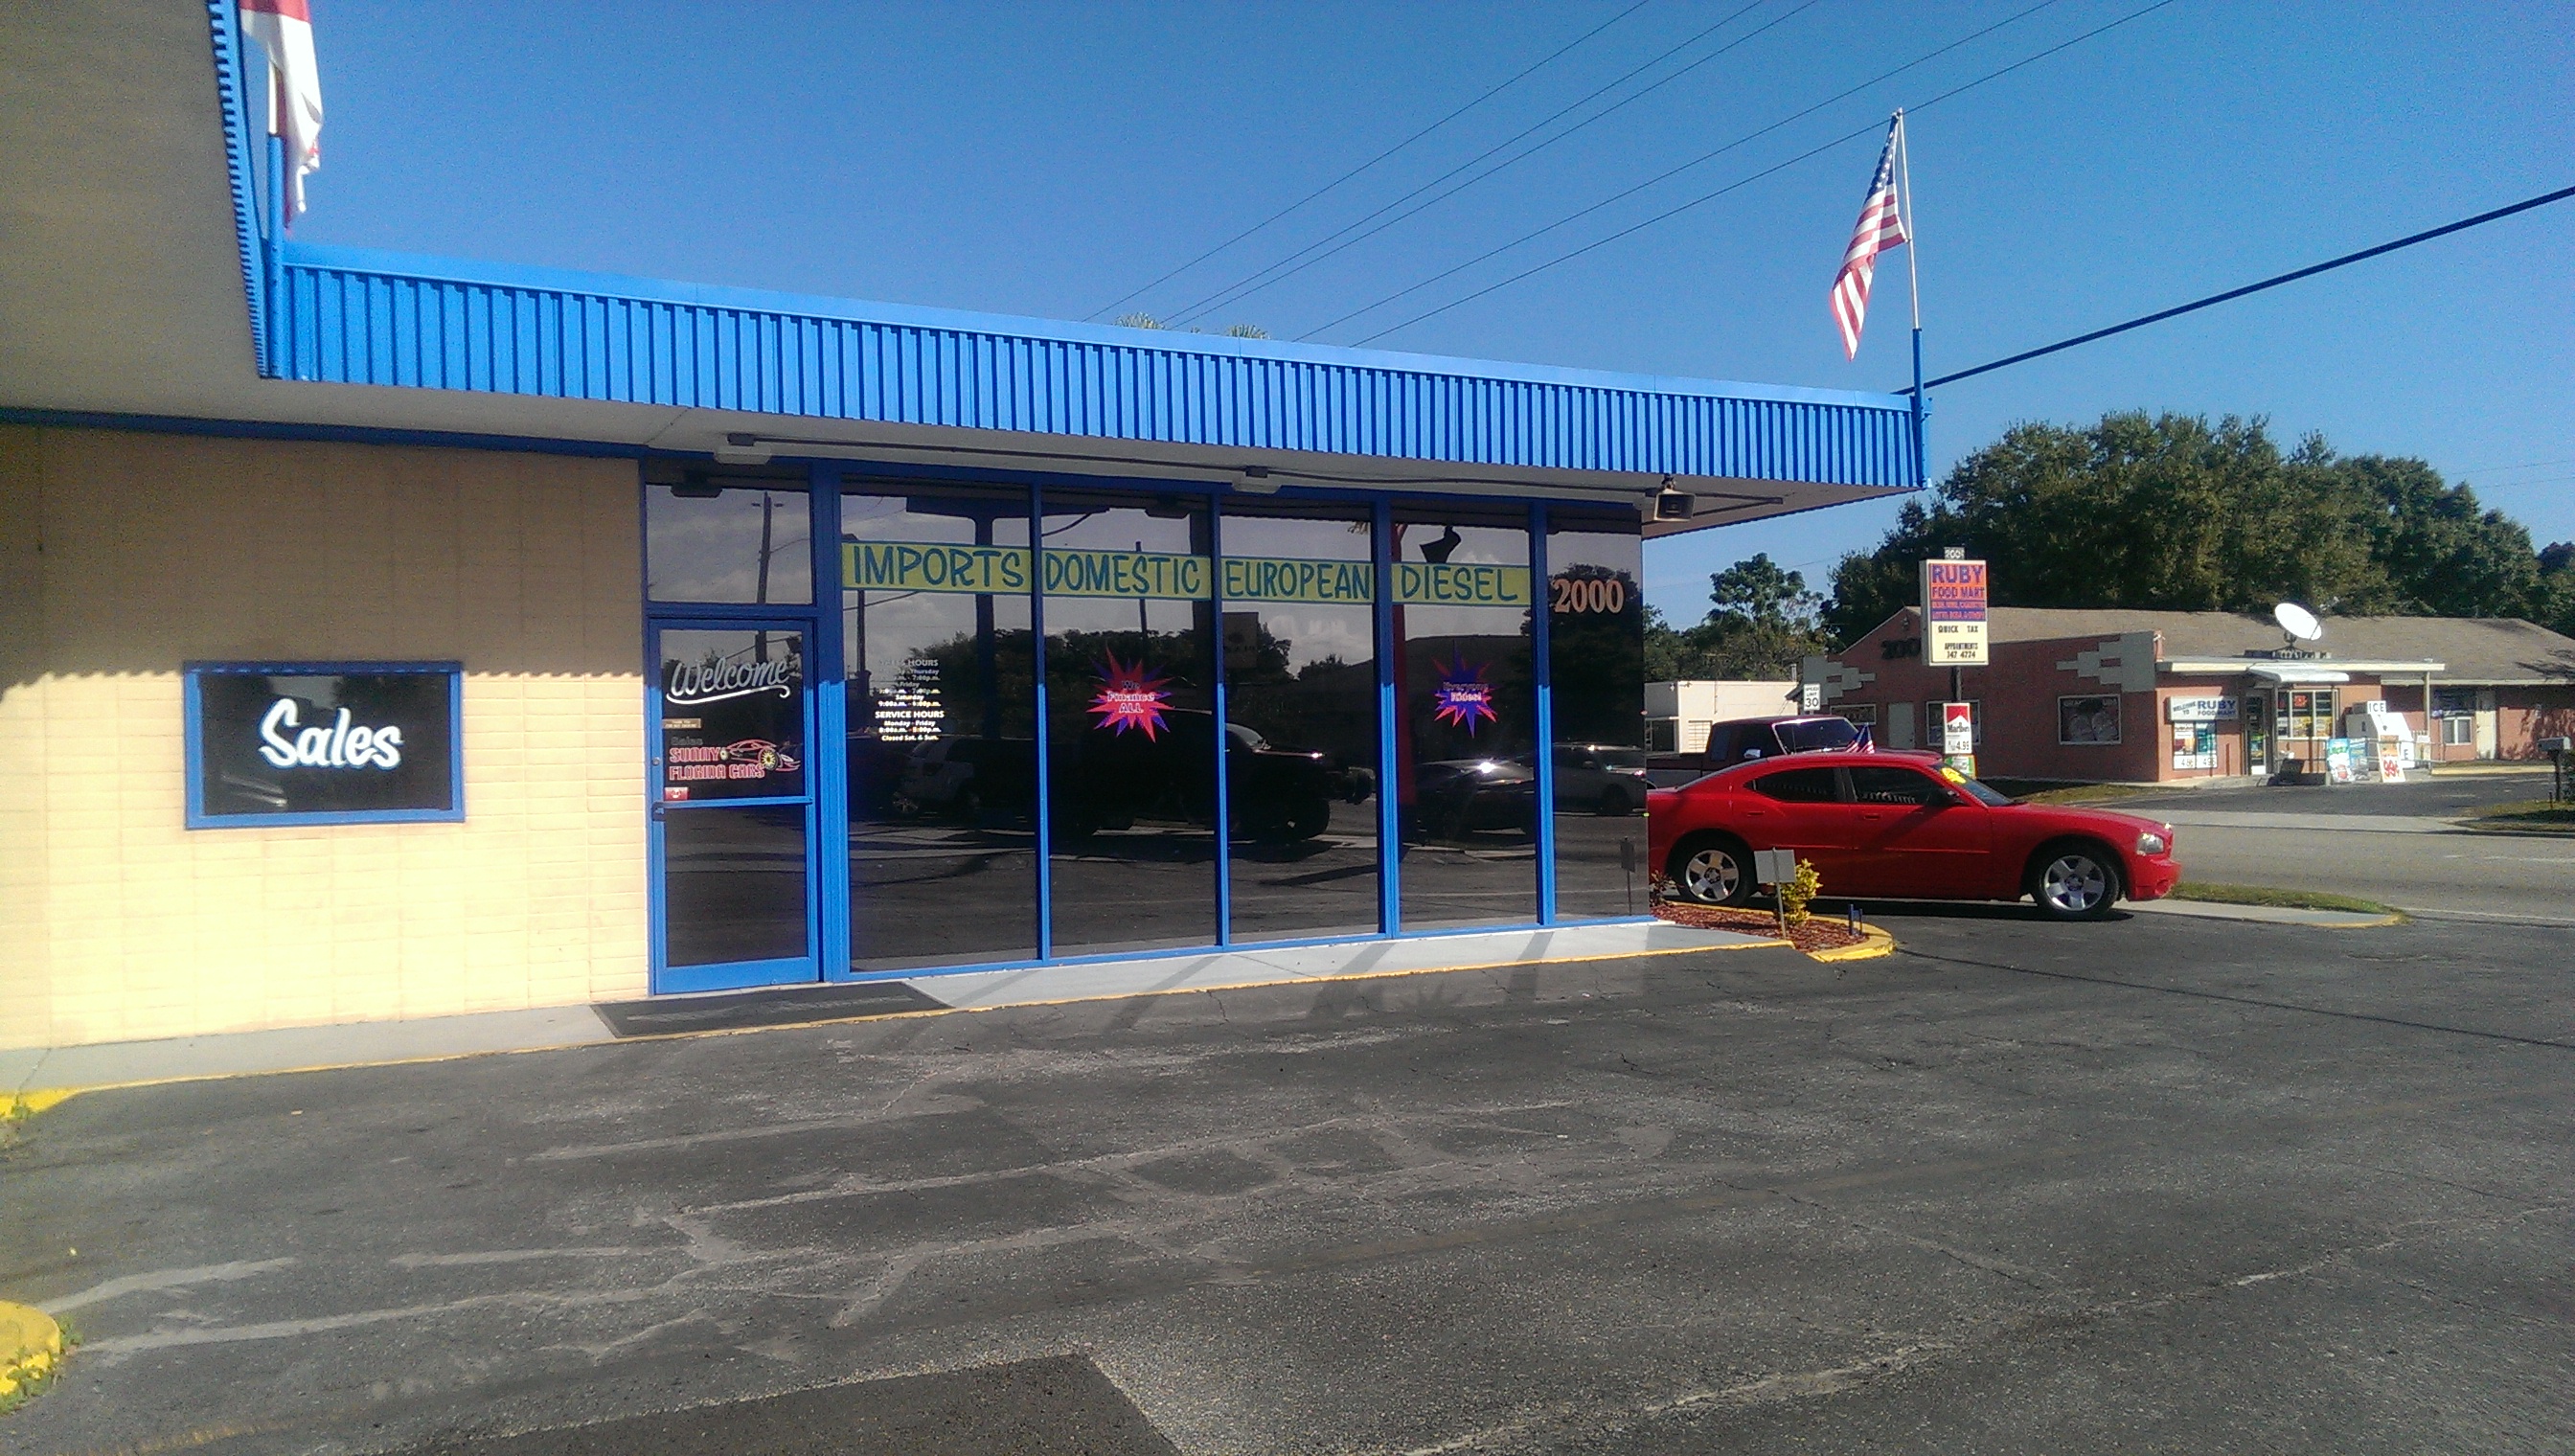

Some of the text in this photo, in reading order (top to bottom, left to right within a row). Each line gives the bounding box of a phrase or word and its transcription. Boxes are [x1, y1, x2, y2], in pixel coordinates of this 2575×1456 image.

[853, 546, 1025, 588] IMPORTS
[1044, 552, 1201, 595] DOMESTIC
[1931, 563, 1984, 584] RUBY
[1224, 559, 1371, 601] EUROPEAN
[1401, 564, 1518, 602] DIESEL
[1553, 578, 1625, 615] 2000
[1931, 585, 1985, 599] FOOD MART
[1937, 625, 1979, 633] QUICK TAX
[907, 658, 939, 667] HOURS
[668, 658, 791, 699] Welcome
[1106, 691, 1155, 702] Finance
[1805, 697, 1819, 708] 30
[1118, 702, 1145, 714] ALL
[2172, 700, 2197, 713] WELCOME
[2197, 700, 2237, 710] RUBY
[2368, 702, 2385, 713] ICE
[913, 710, 946, 718] HOURS
[258, 697, 404, 770] Sales
[669, 746, 721, 763] SUNNY
[669, 762, 765, 781] FLORIDA CARS
